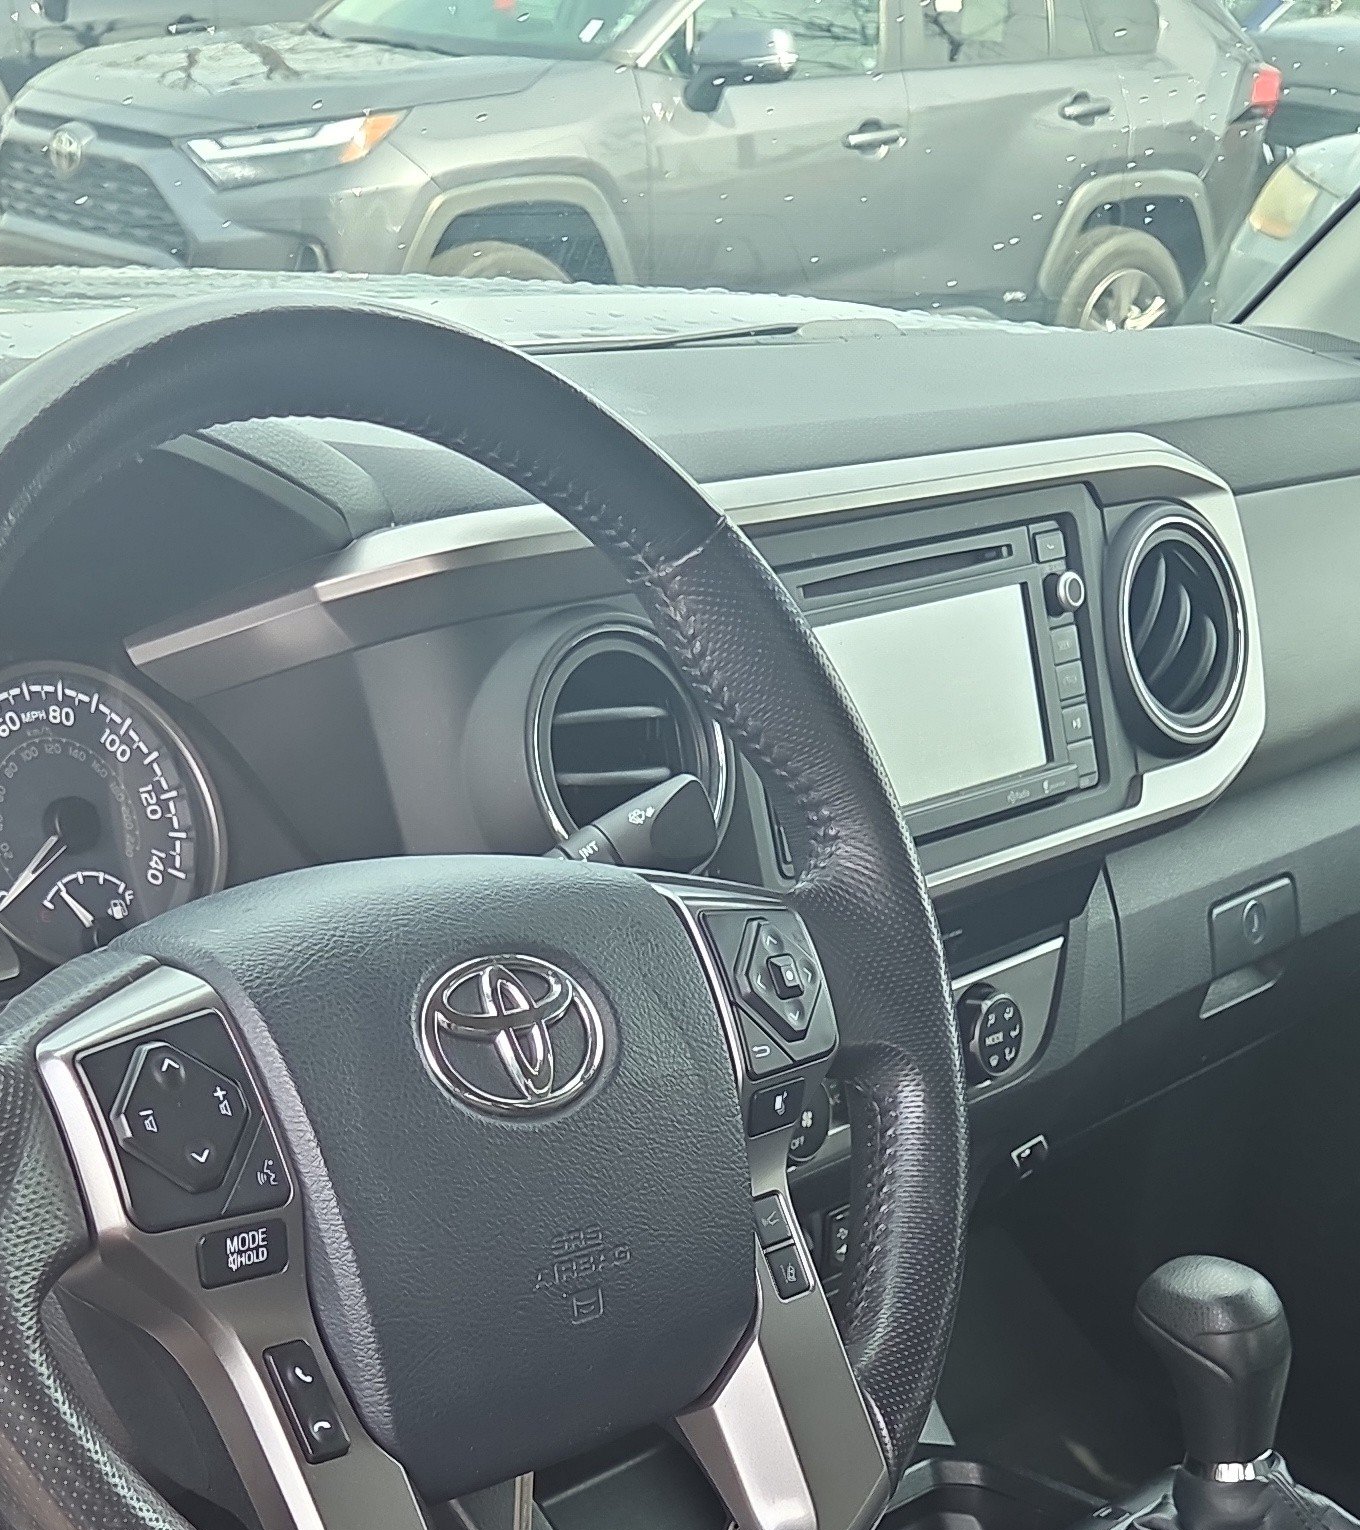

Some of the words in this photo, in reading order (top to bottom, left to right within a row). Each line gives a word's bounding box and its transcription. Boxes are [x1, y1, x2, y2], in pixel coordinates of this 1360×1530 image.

[21, 708, 47, 724] MPH
[48, 705, 75, 726] 80
[100, 728, 131, 763] 100
[139, 784, 162, 820] 120
[146, 849, 167, 886] 140
[226, 1228, 268, 1254] MODE
[237, 1247, 268, 1269] HOLD
